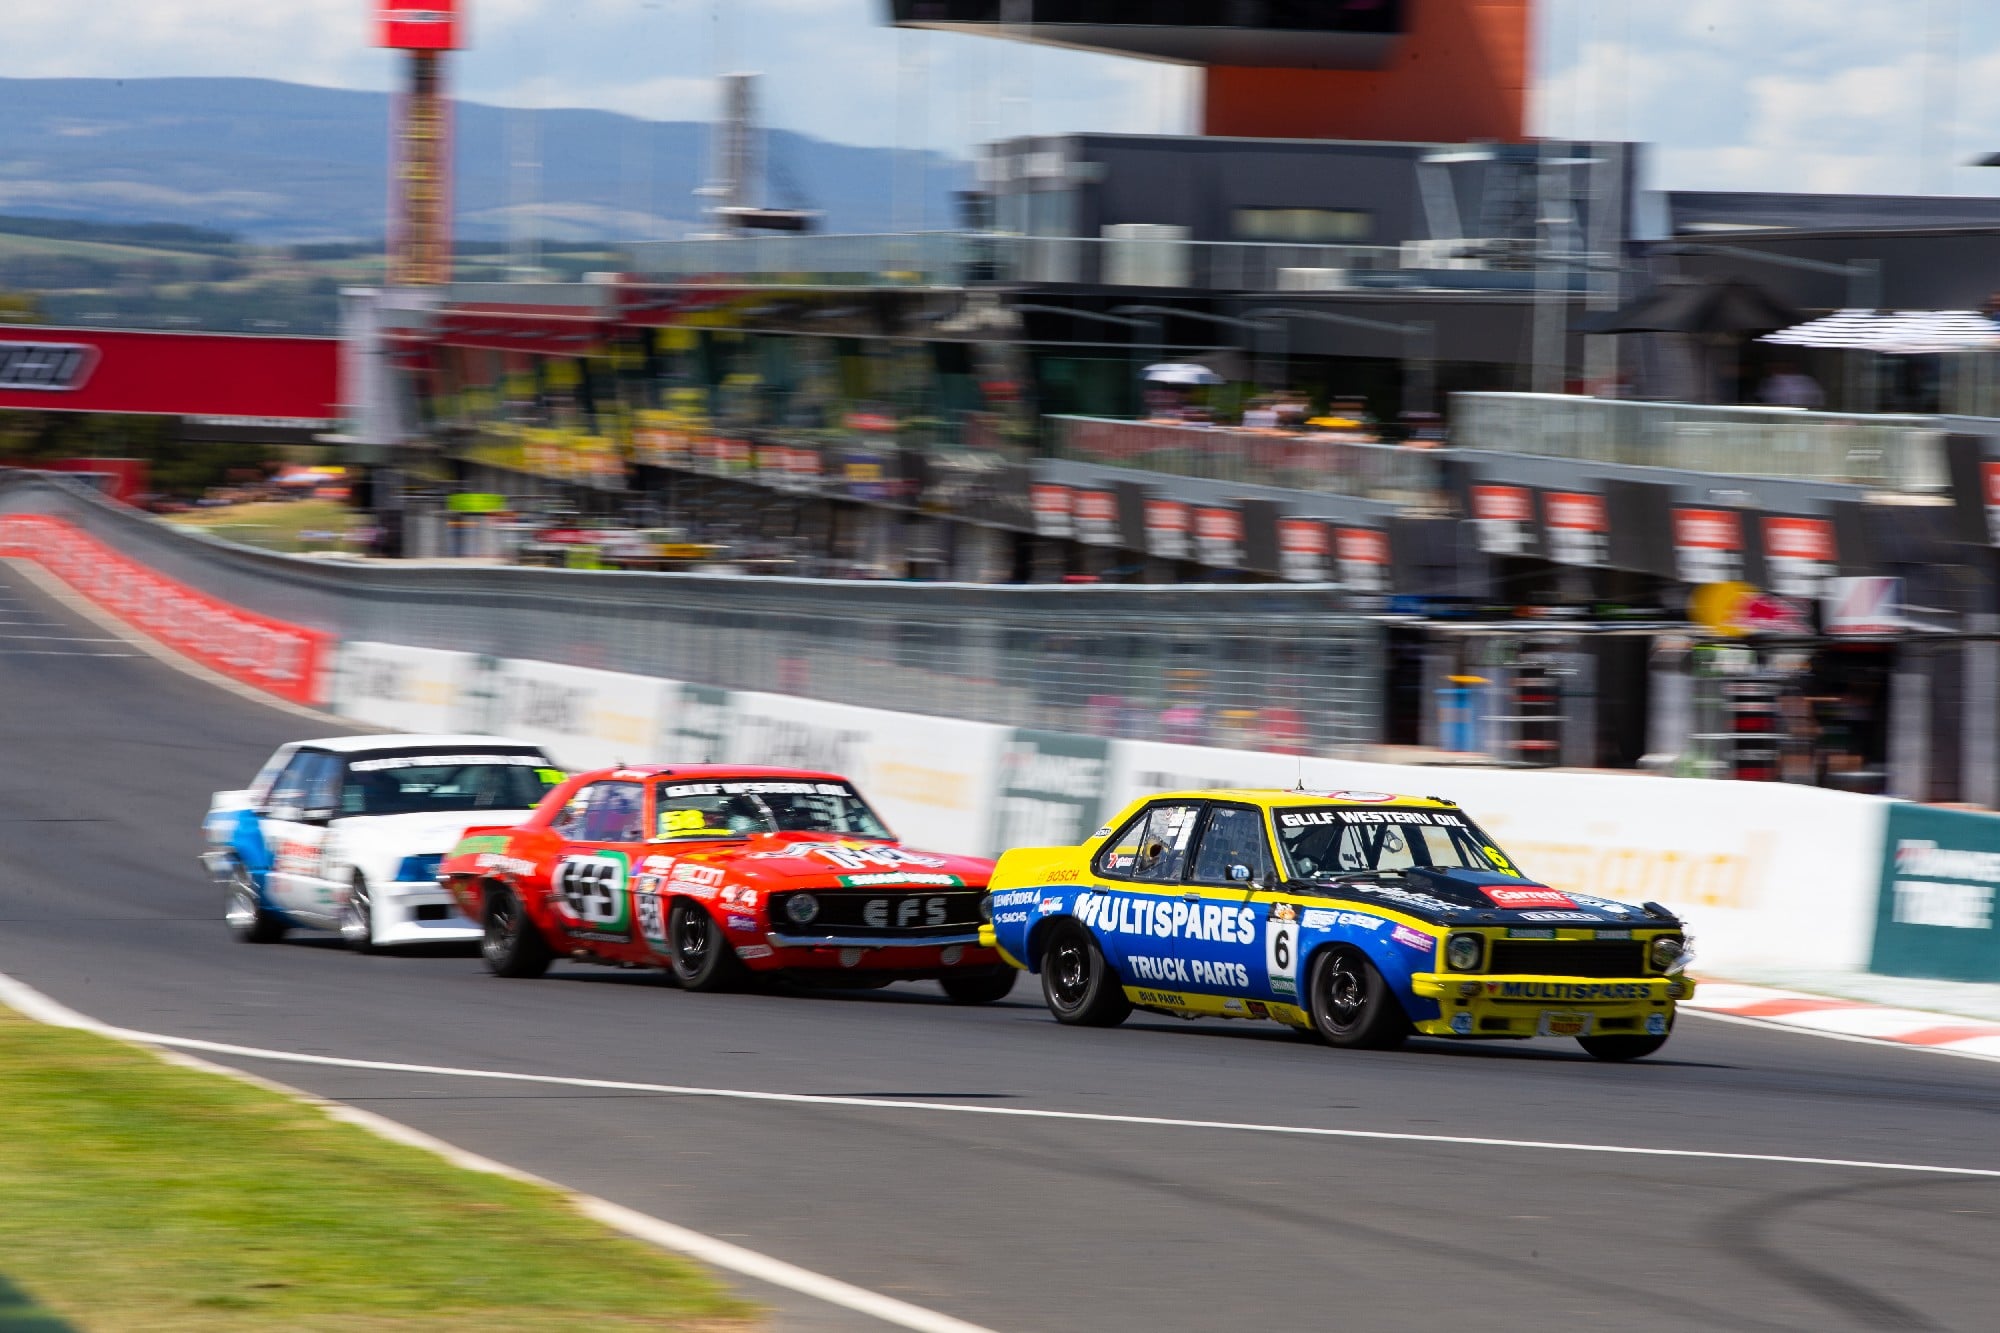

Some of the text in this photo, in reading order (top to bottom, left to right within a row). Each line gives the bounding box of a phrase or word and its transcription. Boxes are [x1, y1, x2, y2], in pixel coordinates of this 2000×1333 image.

[1280, 811, 1467, 827] GULF WESTERN OIL
[1483, 845, 1509, 868] 6
[1046, 869, 1080, 882] BOSCH
[1489, 889, 1565, 901] Garrett
[862, 897, 947, 928] EFS
[1001, 911, 1027, 924] SACHS
[1072, 892, 1256, 945] MULTISPARES
[1274, 929, 1289, 970] 6
[1127, 955, 1249, 987] TRUCK PARTS
[1157, 992, 1186, 1006] PARTS
[1502, 981, 1651, 999] MULTISPARES
